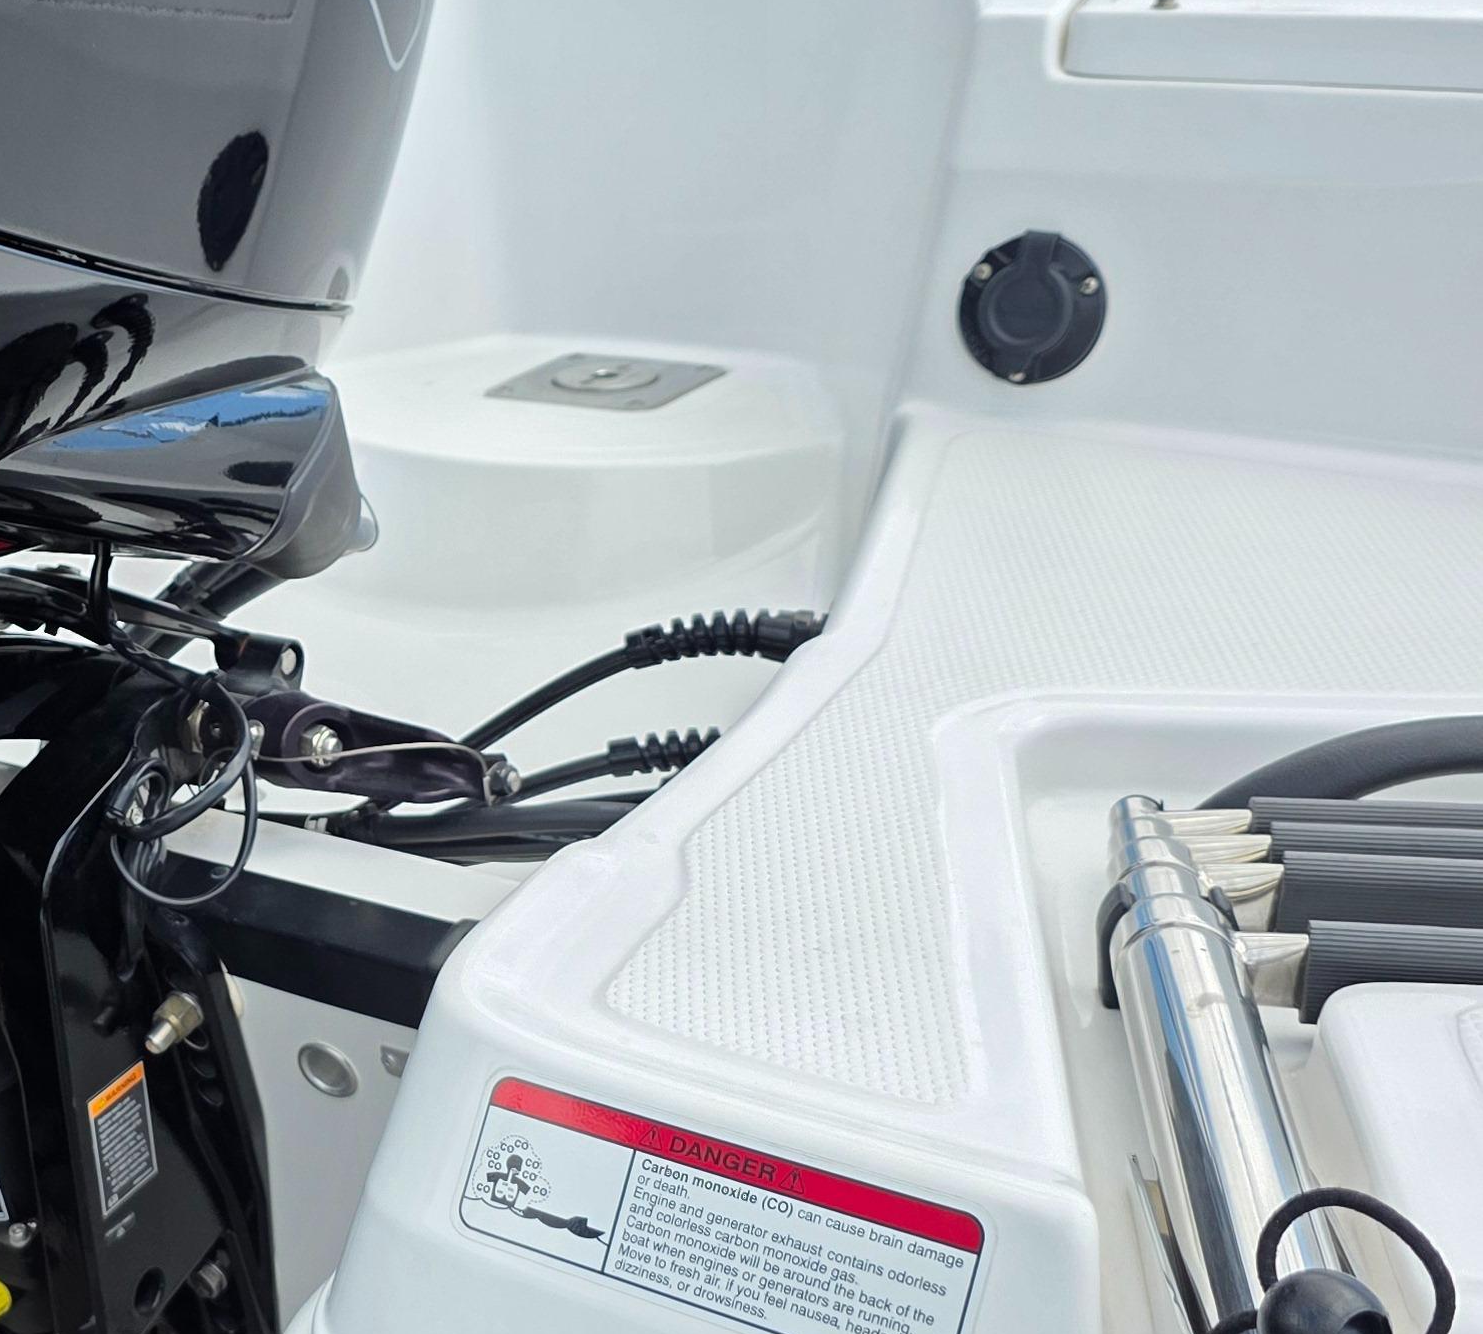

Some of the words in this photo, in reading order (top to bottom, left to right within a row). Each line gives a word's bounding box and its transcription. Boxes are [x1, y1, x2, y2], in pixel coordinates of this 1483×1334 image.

[486, 1149, 501, 1160] CO
[500, 1142, 515, 1154] CO
[514, 1139, 529, 1150] CO
[487, 1160, 502, 1170] CO
[525, 1158, 540, 1169] CO
[669, 1136, 778, 1181] DANGER
[476, 1182, 491, 1194] CO
[522, 1170, 538, 1181] CO
[637, 1174, 651, 1187] or
[653, 1178, 690, 1200] death.
[532, 1185, 548, 1196] CO
[641, 1158, 689, 1184] Carbon
[691, 1176, 758, 1205] monoxide
[761, 1195, 794, 1219] (CO)
[797, 1209, 822, 1225] can
[825, 1217, 866, 1238] cause
[868, 1228, 904, 1251] brain
[906, 1241, 965, 1269] damage
[629, 1202, 654, 1218] and
[655, 1211, 712, 1237] colorless
[714, 1230, 760, 1253] carbon
[762, 1245, 828, 1275] monoxide
[829, 1267, 859, 1286] gas.
[632, 1185, 677, 1210] Engine
[678, 1202, 705, 1219] and
[705, 1211, 769, 1240] generator
[770, 1232, 823, 1258] exhaust
[826, 1250, 885, 1277] contains
[887, 1268, 948, 1297] odorless
[621, 1228, 651, 1249] boat
[652, 1241, 686, 1260] when
[688, 1253, 740, 1278] engines
[741, 1270, 757, 1283] or
[757, 1276, 830, 1308] generators
[832, 1300, 855, 1316] are
[626, 1214, 671, 1240] Carbon
[673, 1232, 737, 1261] monoxide
[739, 1253, 761, 1269] will
[762, 1259, 780, 1276] be
[782, 1268, 832, 1292] around
[833, 1282, 856, 1300] the
[858, 1290, 893, 1313] back
[895, 1305, 912, 1318] of
[912, 1307, 935, 1327] the
[612, 1259, 673, 1290] dizziness,
[676, 1280, 691, 1293] or
[693, 1285, 767, 1320] drowsiness.
[617, 1242, 652, 1264] Move
[654, 1255, 667, 1270] to
[669, 1259, 701, 1282] fresh
[703, 1273, 721, 1290] air,
[724, 1278, 735, 1292] if
[734, 1284, 761, 1302] you
[763, 1290, 788, 1311] feel
[789, 1302, 841, 1331] nausea,
